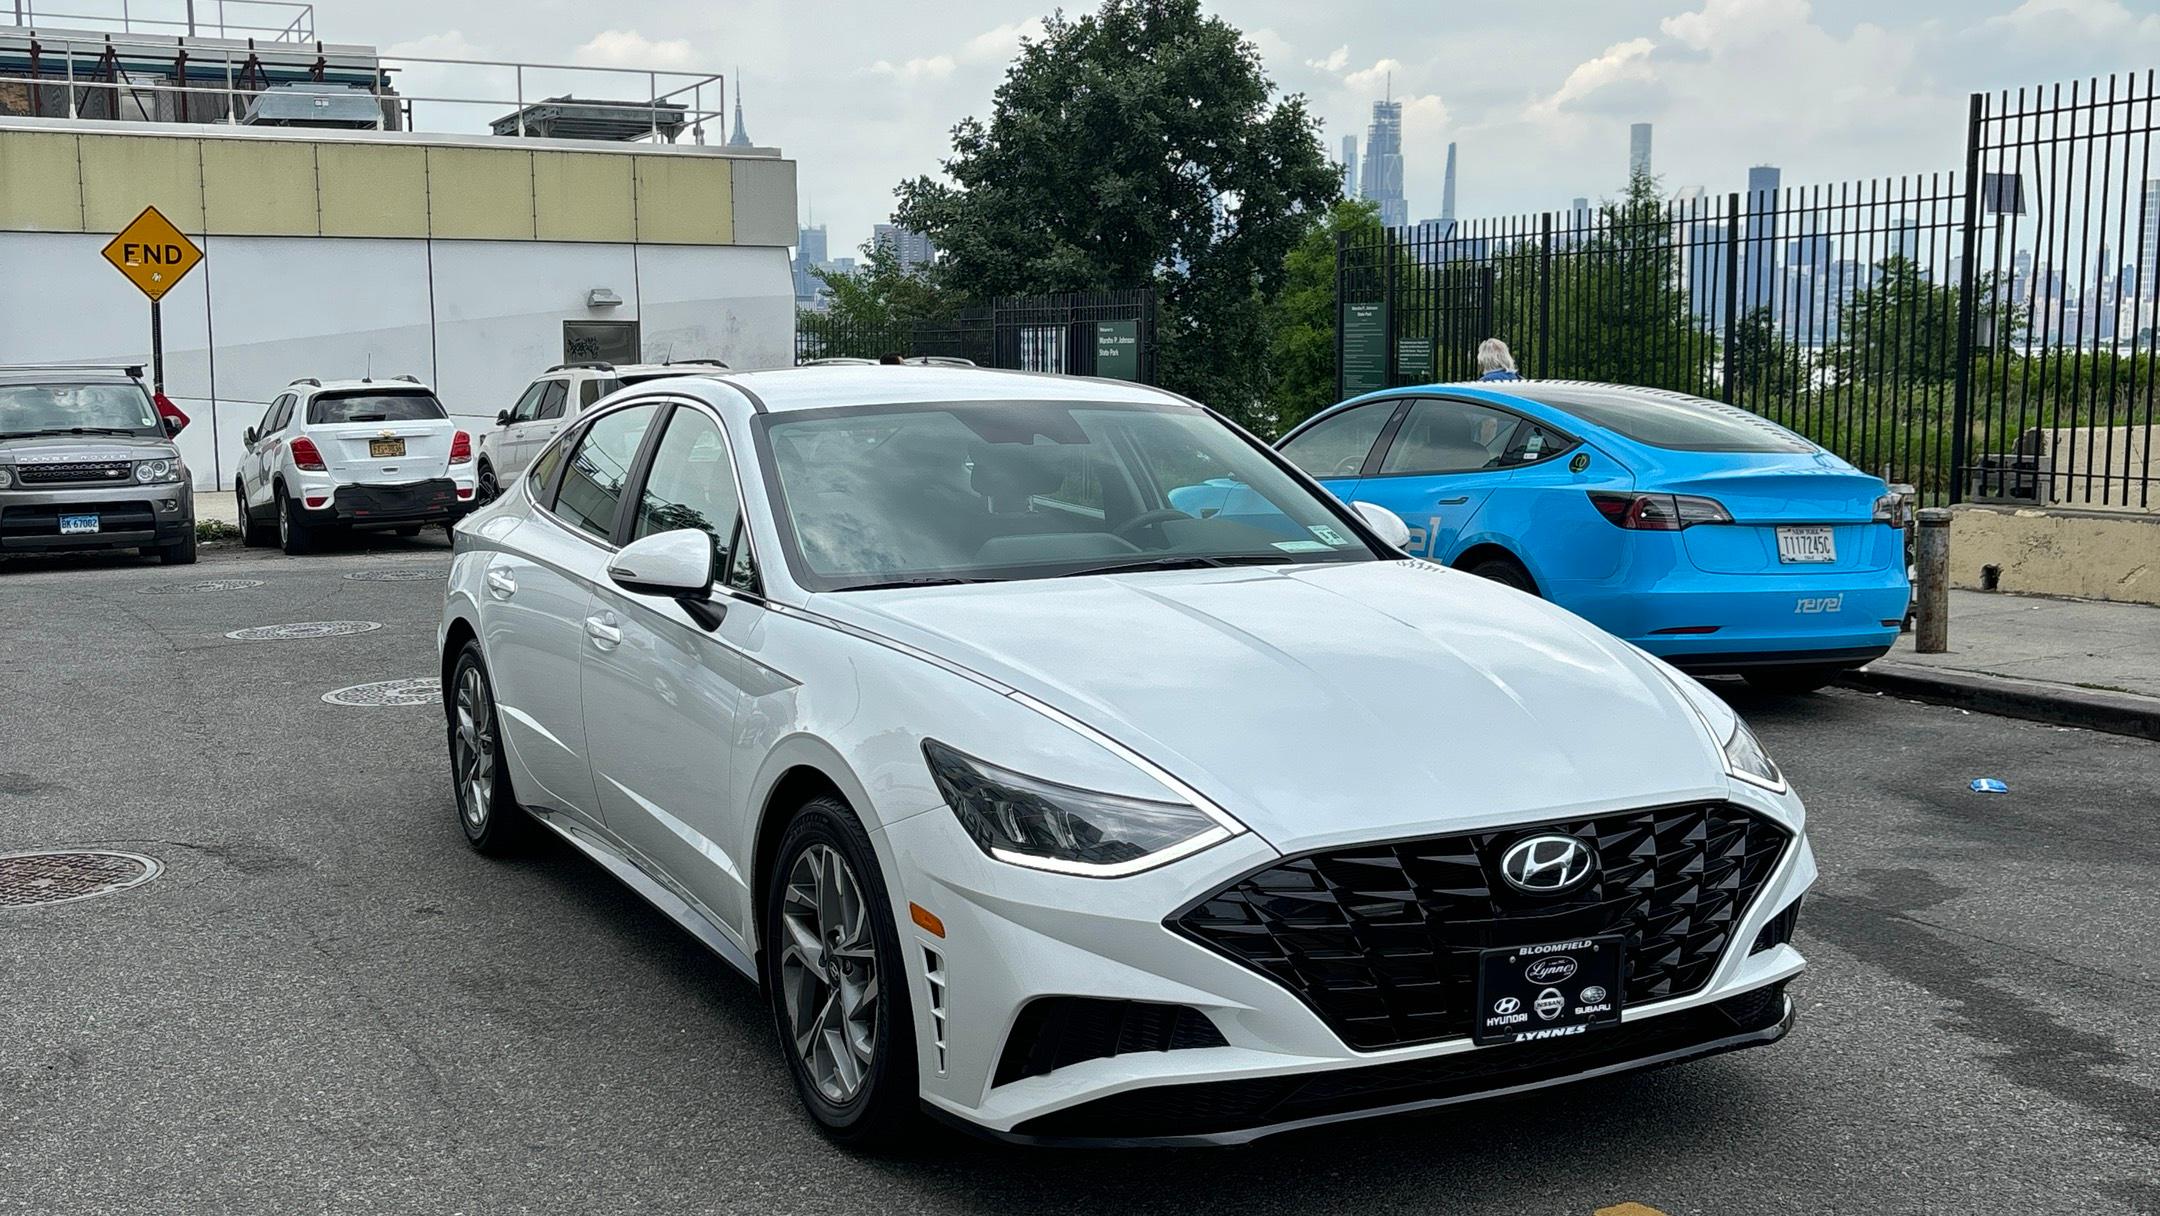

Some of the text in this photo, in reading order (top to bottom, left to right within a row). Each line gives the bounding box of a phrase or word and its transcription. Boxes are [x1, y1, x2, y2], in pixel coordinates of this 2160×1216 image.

[123, 243, 183, 265] END
[1783, 536, 1831, 554] T117245C
[1794, 593, 1843, 613] revel
[1519, 940, 1592, 956] BLOOMFIELD
[1529, 961, 1574, 979] Lynnes
[1575, 1003, 1611, 1015] SUBARU
[1486, 1012, 1528, 1027] HYUNDAI
[1515, 1024, 1587, 1042] LYNNES
